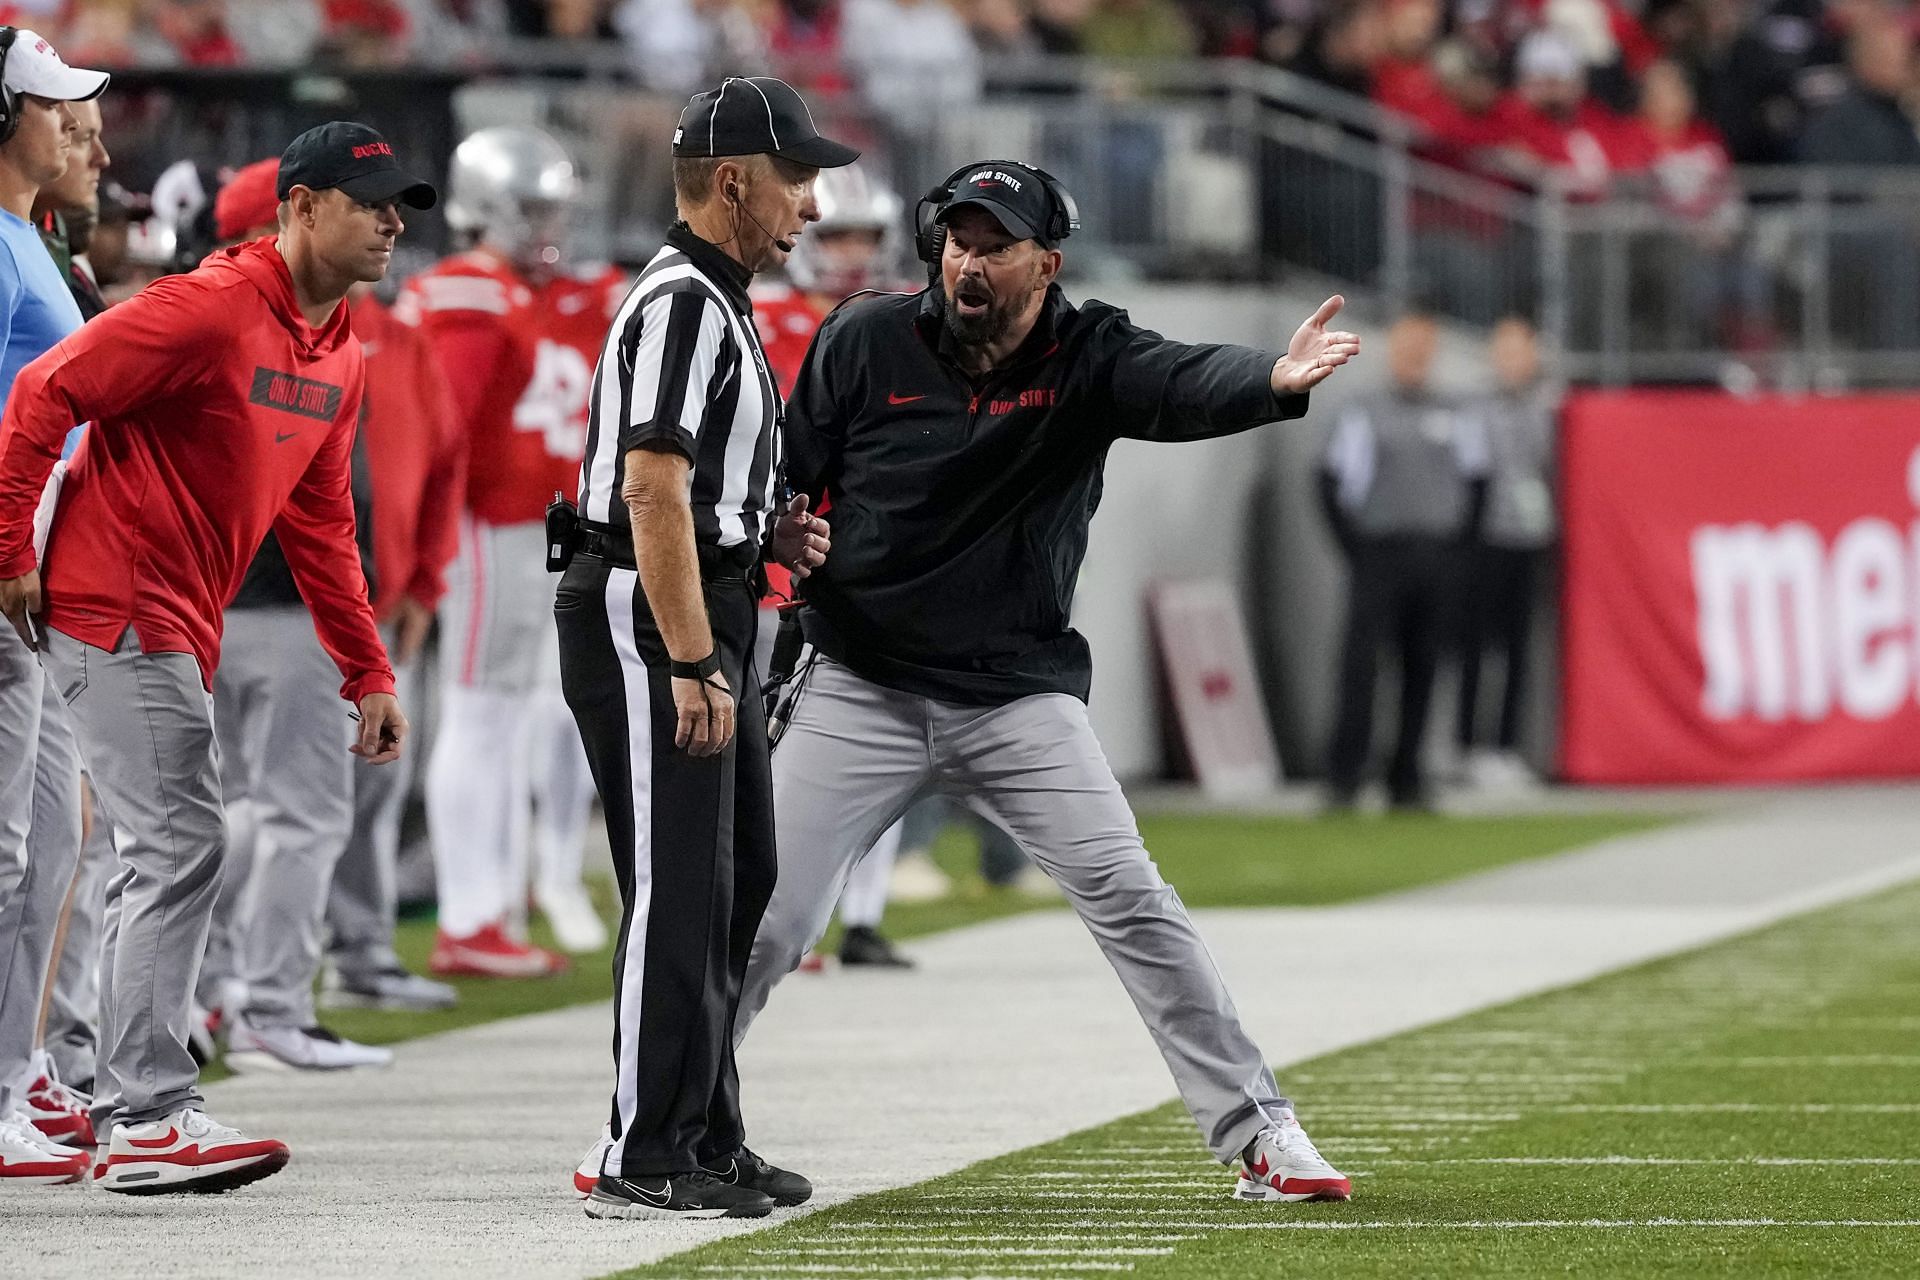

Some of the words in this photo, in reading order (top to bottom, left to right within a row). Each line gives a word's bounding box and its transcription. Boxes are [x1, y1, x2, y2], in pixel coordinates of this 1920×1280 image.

[969, 171, 993, 184] OHIO
[994, 171, 1022, 193] STATE
[269, 376, 299, 406] OHIO
[298, 384, 328, 413] STATE
[1019, 389, 1056, 407] STATE
